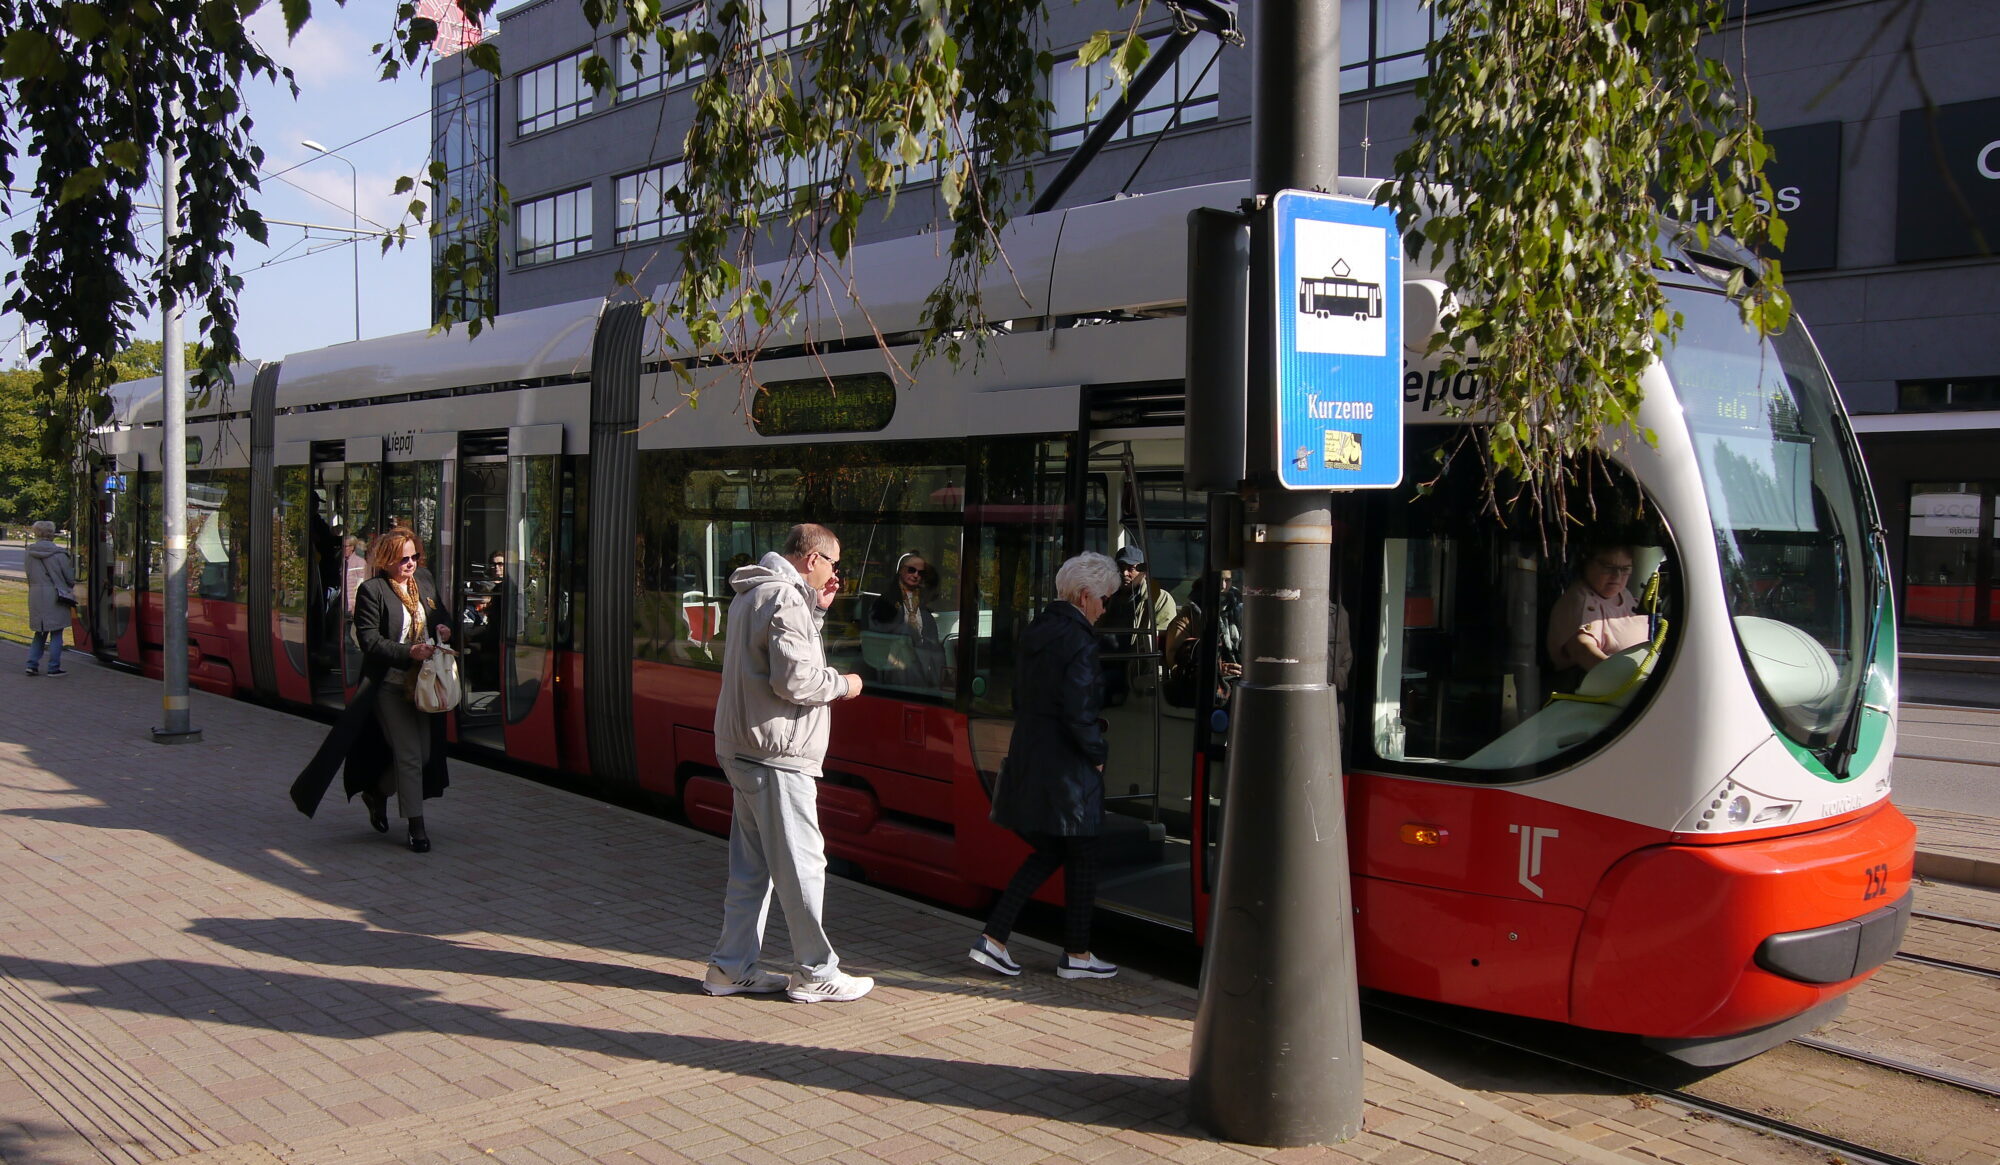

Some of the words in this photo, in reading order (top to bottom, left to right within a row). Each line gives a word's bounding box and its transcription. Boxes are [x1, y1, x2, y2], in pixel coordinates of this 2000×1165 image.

[1307, 393, 1374, 420] Kurzeme
[386, 429, 416, 455] Liepāj
[1863, 863, 1888, 901] 252
